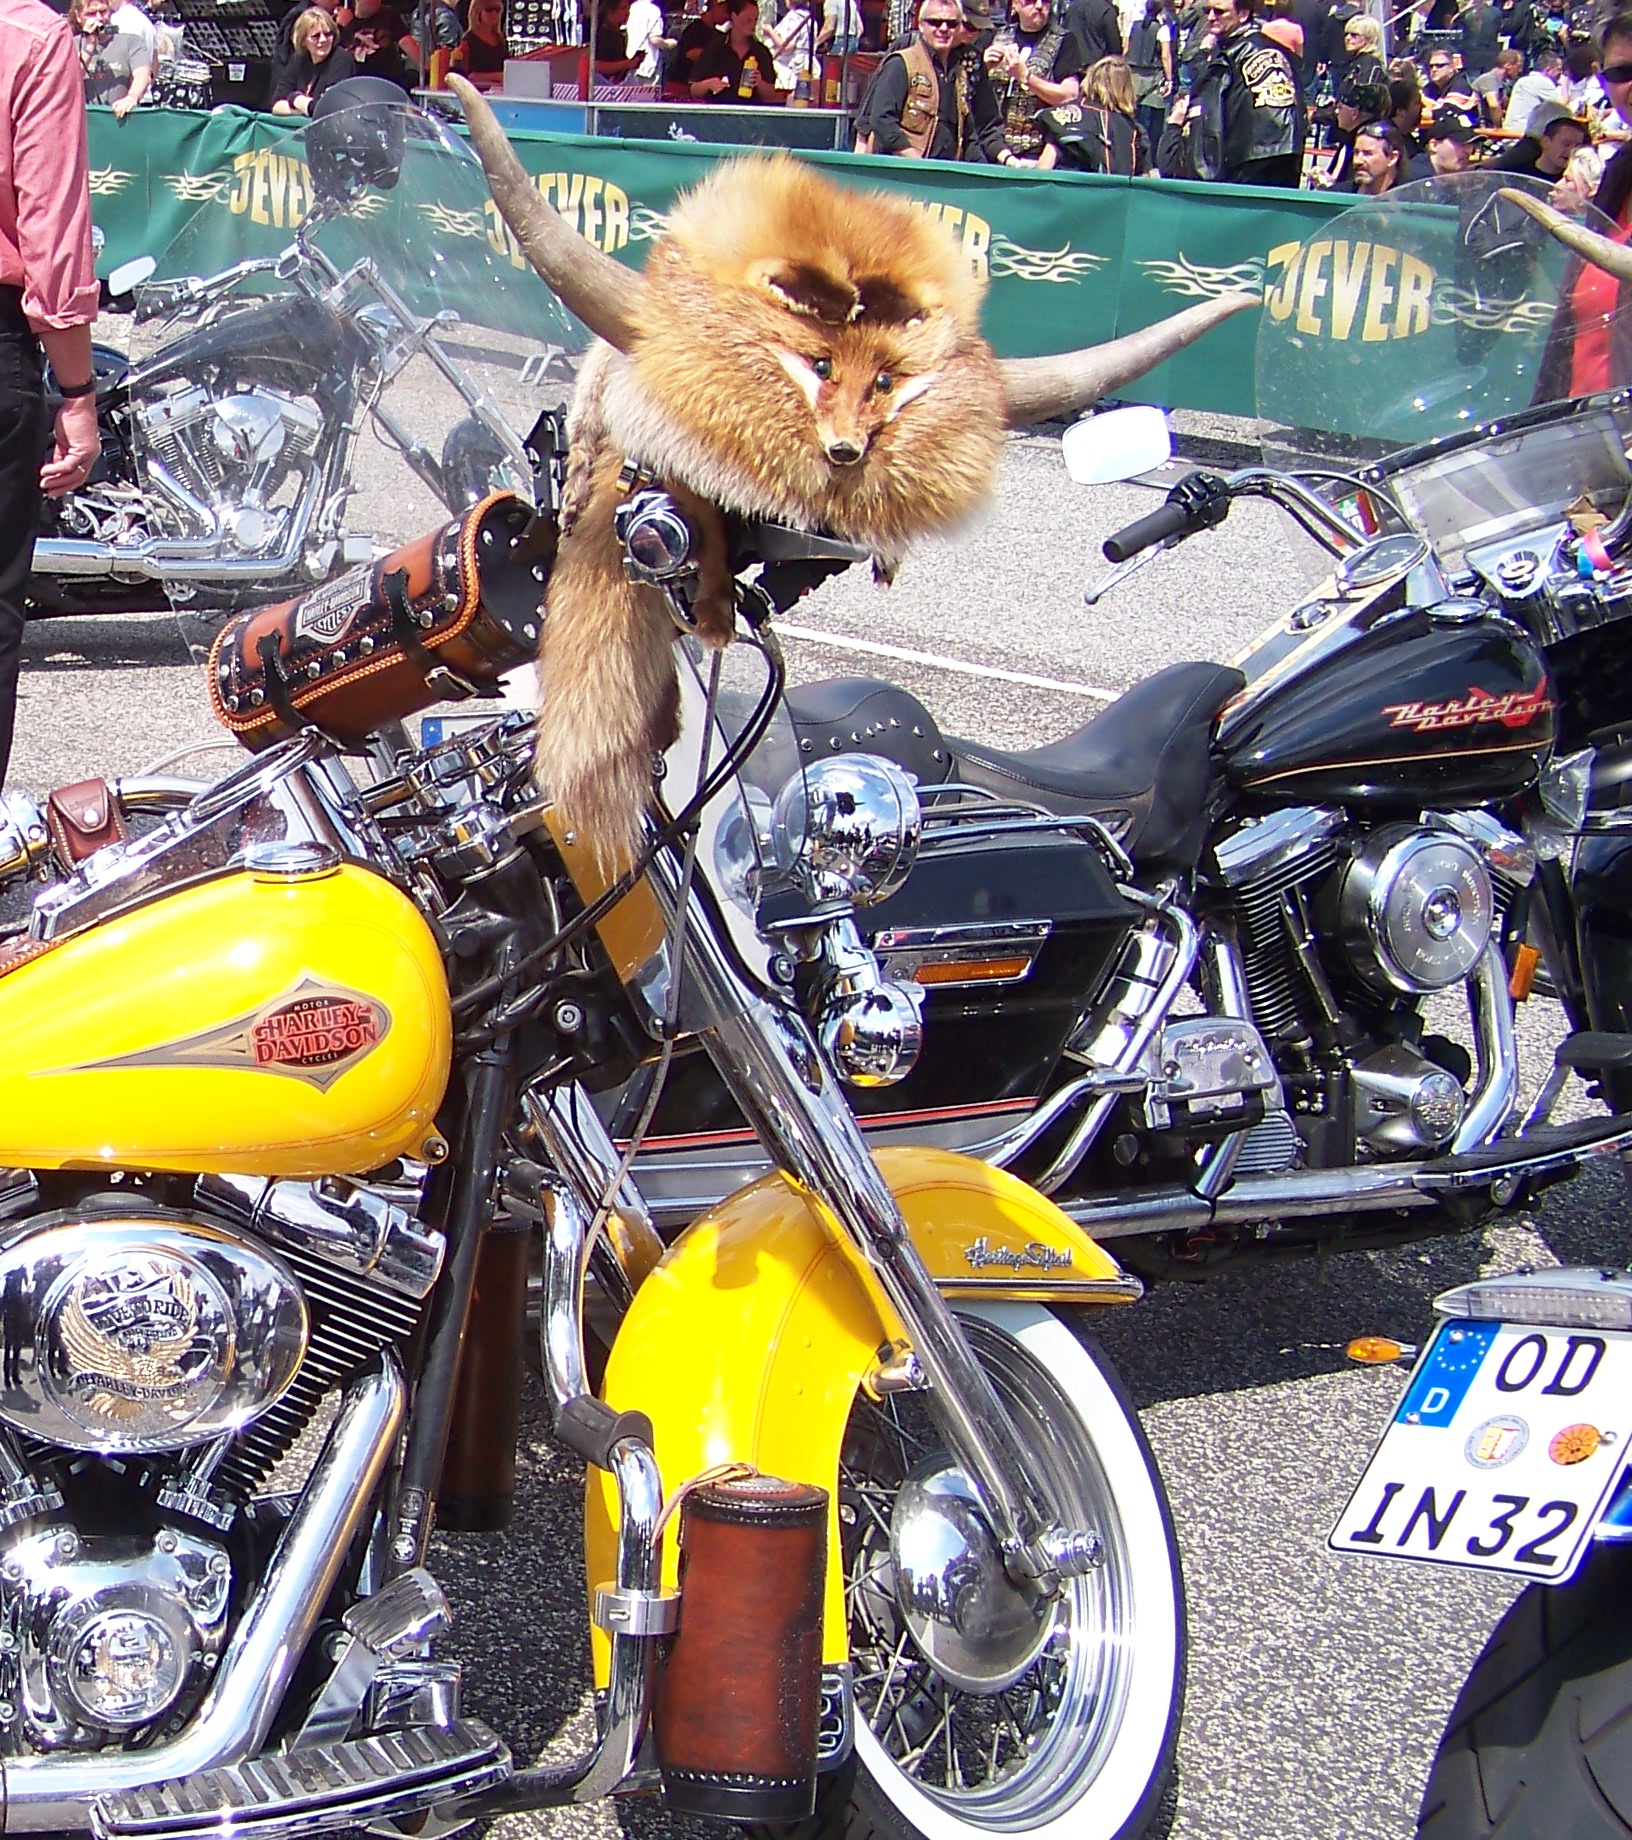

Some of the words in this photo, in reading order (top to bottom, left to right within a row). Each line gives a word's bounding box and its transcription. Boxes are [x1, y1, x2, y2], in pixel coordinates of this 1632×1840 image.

[1264, 240, 1441, 342] JEVER
[1415, 700, 1556, 732] Davidson
[254, 1002, 373, 1040] HARLEY
[294, 1000, 329, 1011] MOTOR
[254, 1023, 380, 1066] DAVIDSON
[301, 1053, 338, 1064] CYCLES
[153, 1300, 190, 1325] RIDE
[1495, 1333, 1606, 1396] OD
[1419, 1388, 1450, 1413] D
[1350, 1482, 1468, 1550] IN
[1466, 1494, 1578, 1567] 32
